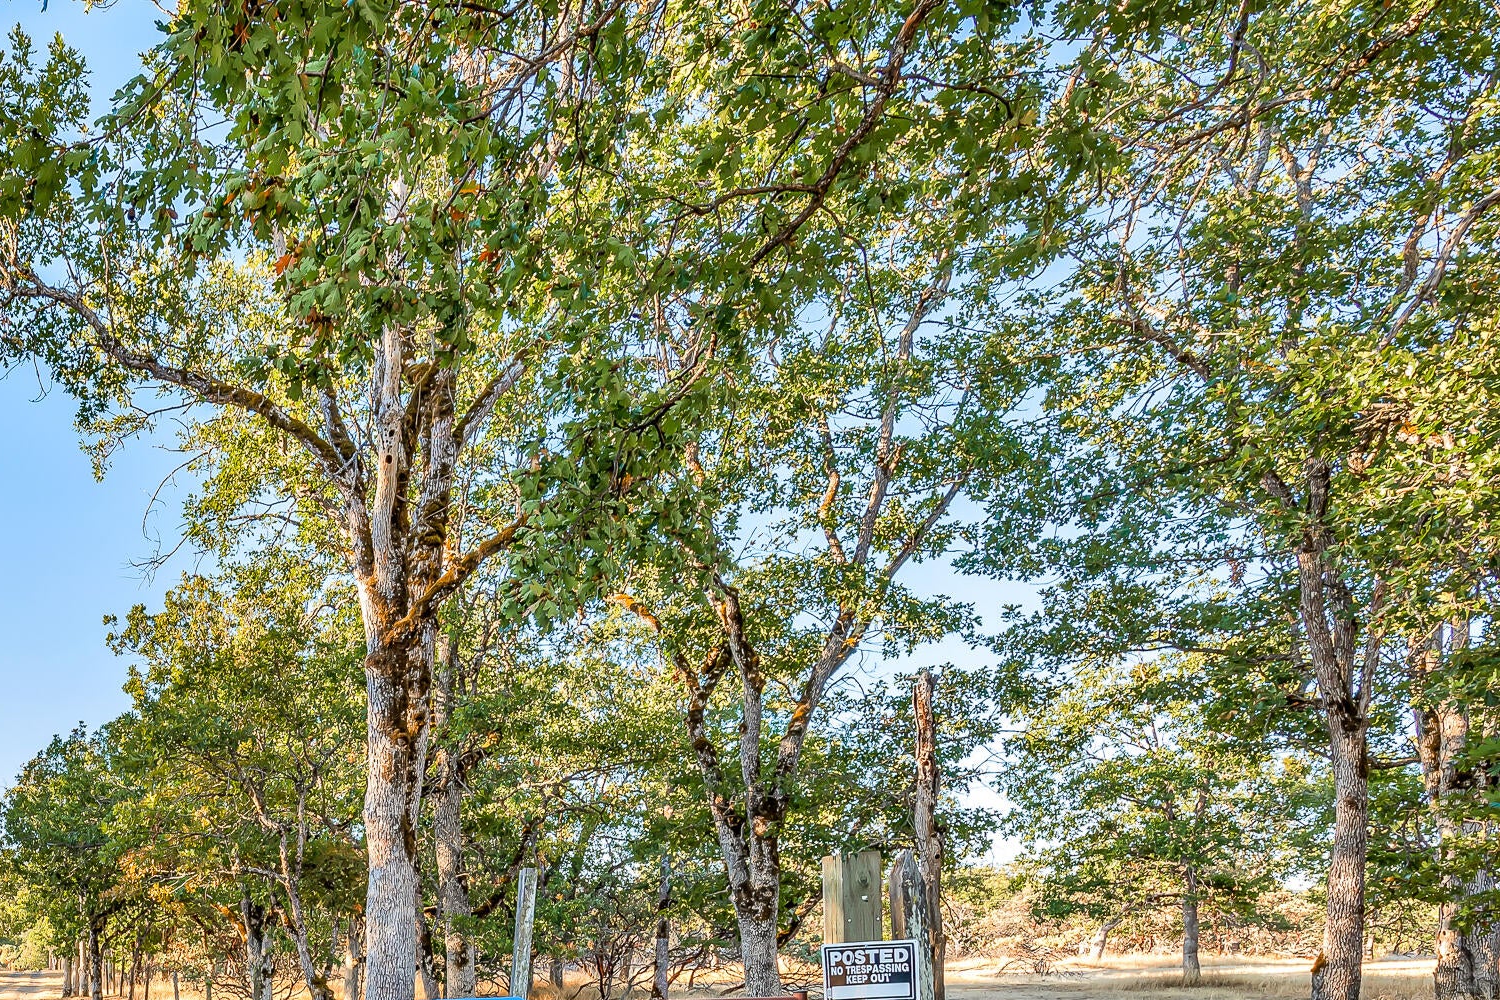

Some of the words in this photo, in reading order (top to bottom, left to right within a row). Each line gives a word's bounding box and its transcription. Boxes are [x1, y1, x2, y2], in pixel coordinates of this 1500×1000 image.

[829, 948, 909, 966] POSTED
[830, 966, 843, 976] NO
[846, 963, 910, 974] TRESPASSING
[846, 974, 868, 984] KEEP
[870, 973, 892, 982] OUT
